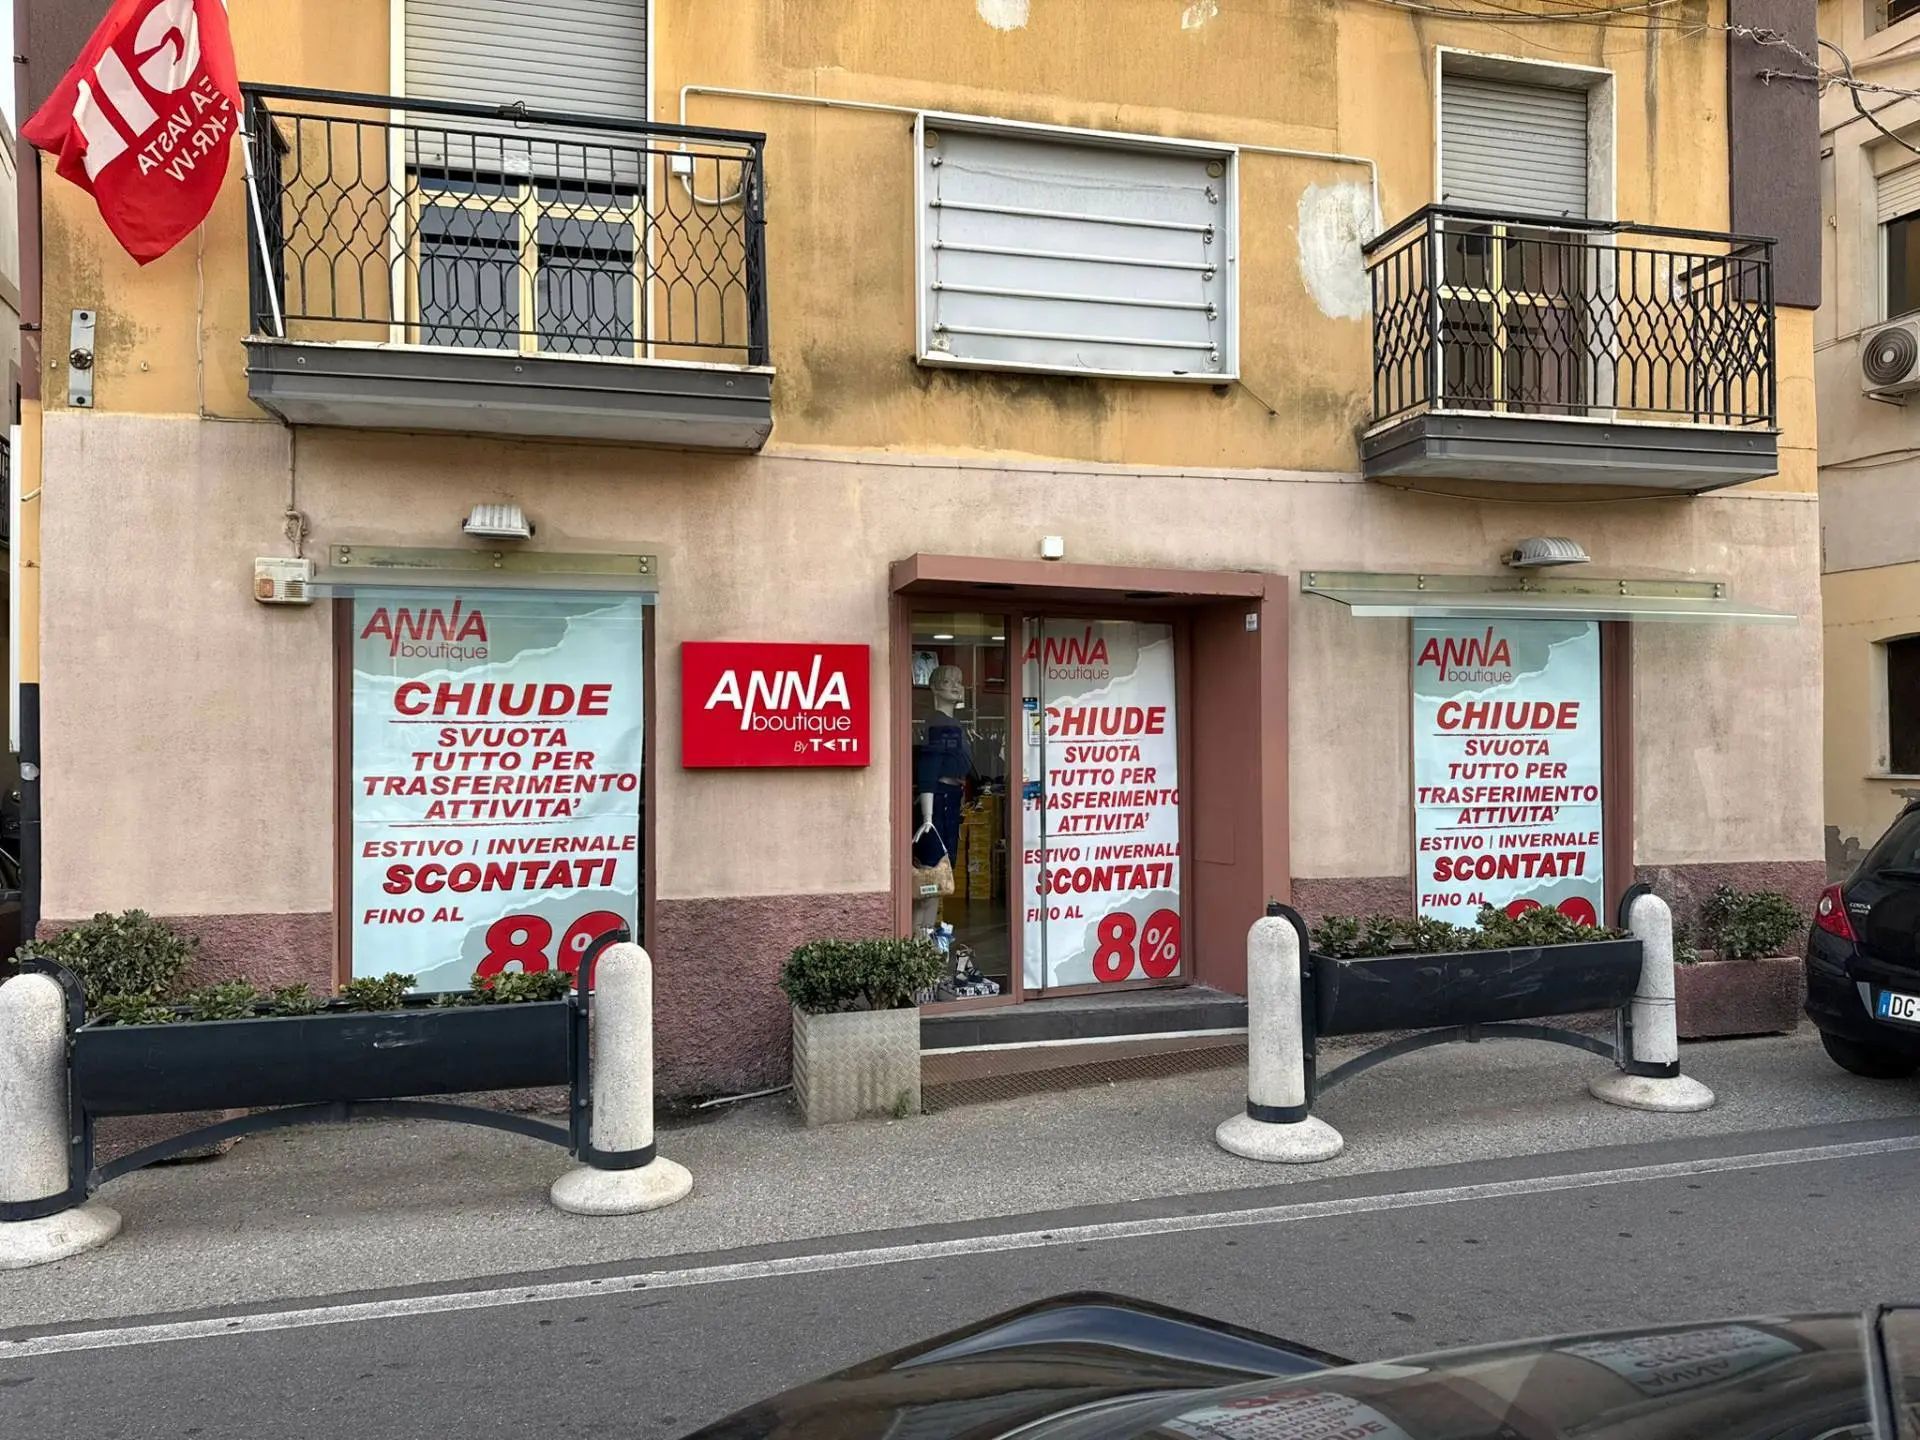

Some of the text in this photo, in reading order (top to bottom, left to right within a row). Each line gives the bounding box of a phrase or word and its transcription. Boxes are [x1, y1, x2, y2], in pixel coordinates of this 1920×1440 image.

[360, 596, 488, 656] ANNA
[401, 642, 488, 661] boutique
[1022, 626, 1109, 676] ANNA
[1417, 626, 1511, 681] ANNA
[1048, 666, 1109, 682] boutique
[1448, 669, 1512, 684] boutique
[393, 681, 613, 717] CHIUDE
[704, 654, 851, 731] ANNA
[752, 712, 851, 735] boutique
[1436, 701, 1580, 730] CHIUDE
[437, 728, 567, 748] SVUOTA
[794, 741, 809, 754] By
[1465, 739, 1550, 756] SVUOTA
[411, 751, 595, 771] TUTTO PER
[1064, 745, 1140, 763] SVUOTA
[1049, 767, 1157, 786] TUTTO PER
[1448, 762, 1568, 780] TUTTO PER
[363, 773, 638, 796] TRASFERIMENTO
[1418, 785, 1599, 803] TRASFERIMENTO
[424, 798, 581, 820] ATTIVITA'
[1457, 806, 1560, 824] ATTIVITA'
[1058, 813, 1150, 832] ATTIVITA'
[362, 839, 463, 858] ESTIVO
[486, 835, 636, 855] INVERNALE
[1420, 836, 1484, 851] ESTIVO
[1499, 832, 1600, 848] INVERNALE
[1024, 847, 1080, 864] ESTIVO
[1432, 851, 1586, 882] SCONTATI
[382, 858, 618, 895] SCONTATI
[1035, 863, 1173, 896] SCONTATI
[1421, 892, 1487, 907] FINO AL
[363, 907, 465, 925] FINO AL
[1064, 906, 1084, 919] AL
